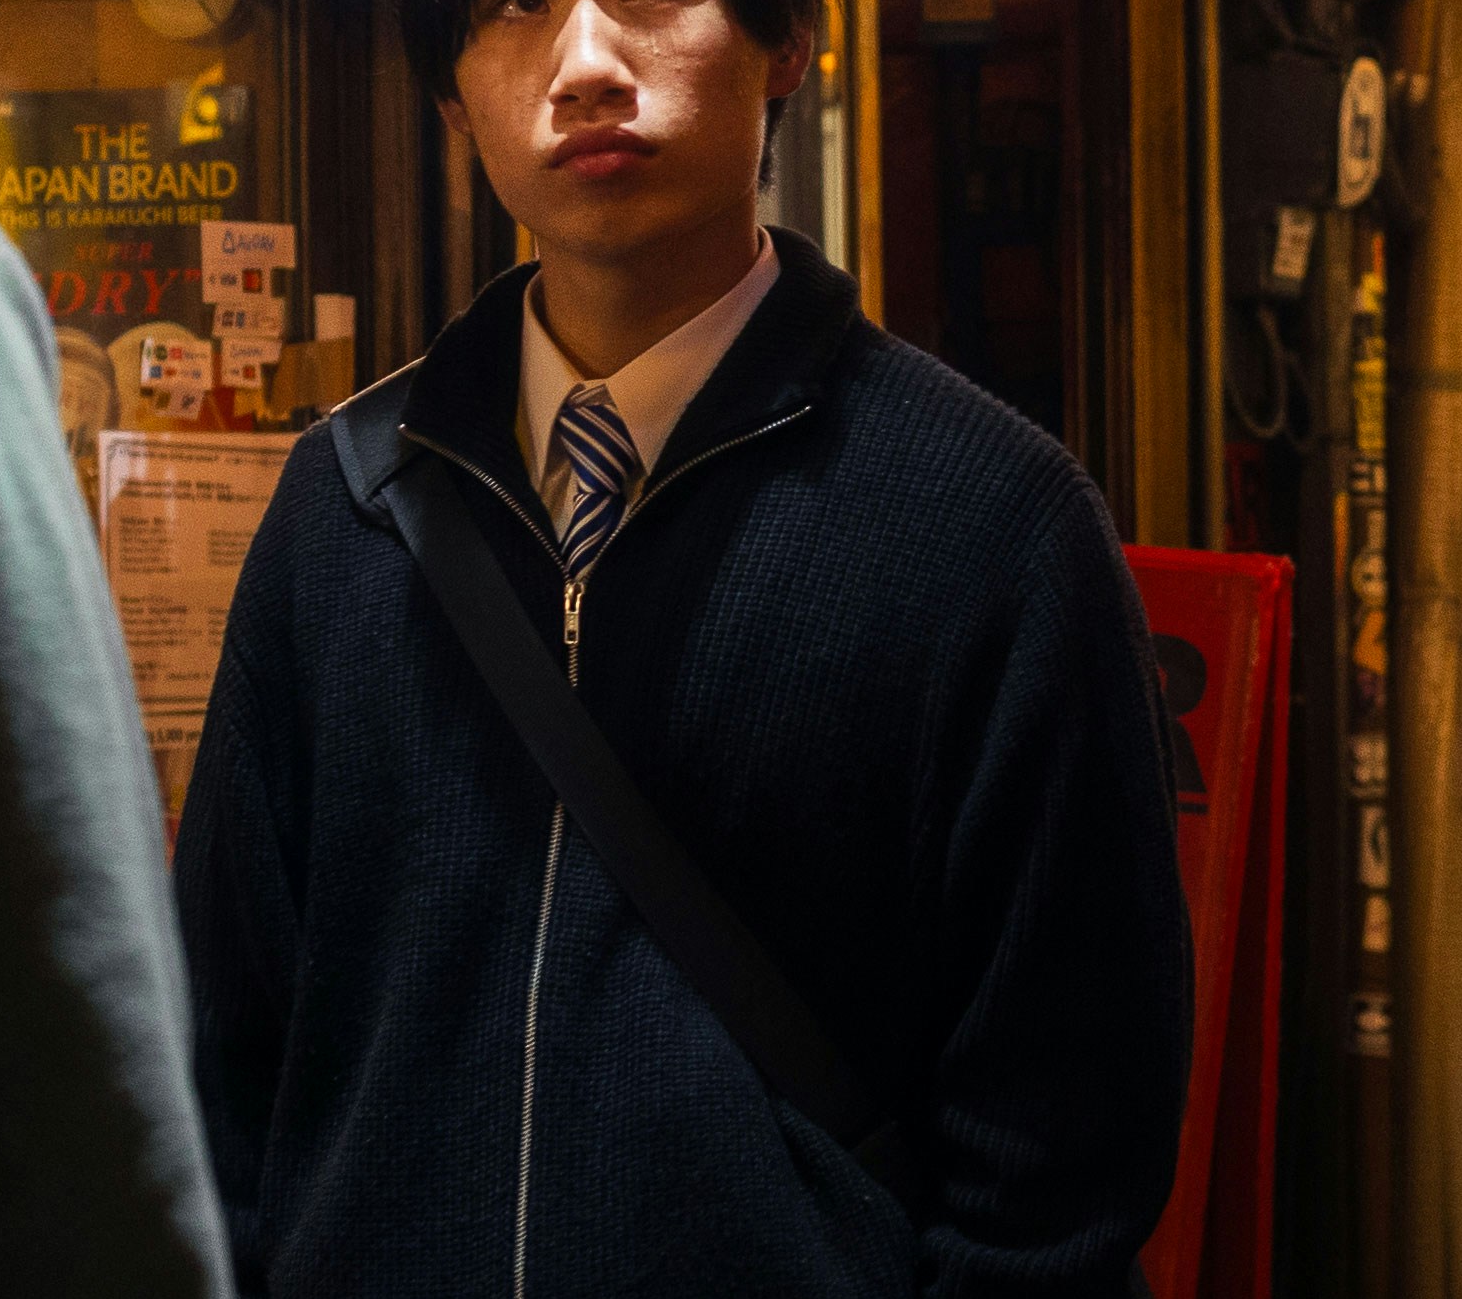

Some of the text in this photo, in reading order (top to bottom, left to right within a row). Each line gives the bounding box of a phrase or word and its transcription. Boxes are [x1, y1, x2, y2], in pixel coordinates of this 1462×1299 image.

[75, 122, 150, 161] THE
[108, 161, 238, 201] BRAND
[45, 209, 63, 229] IS
[176, 204, 222, 223] BEER
